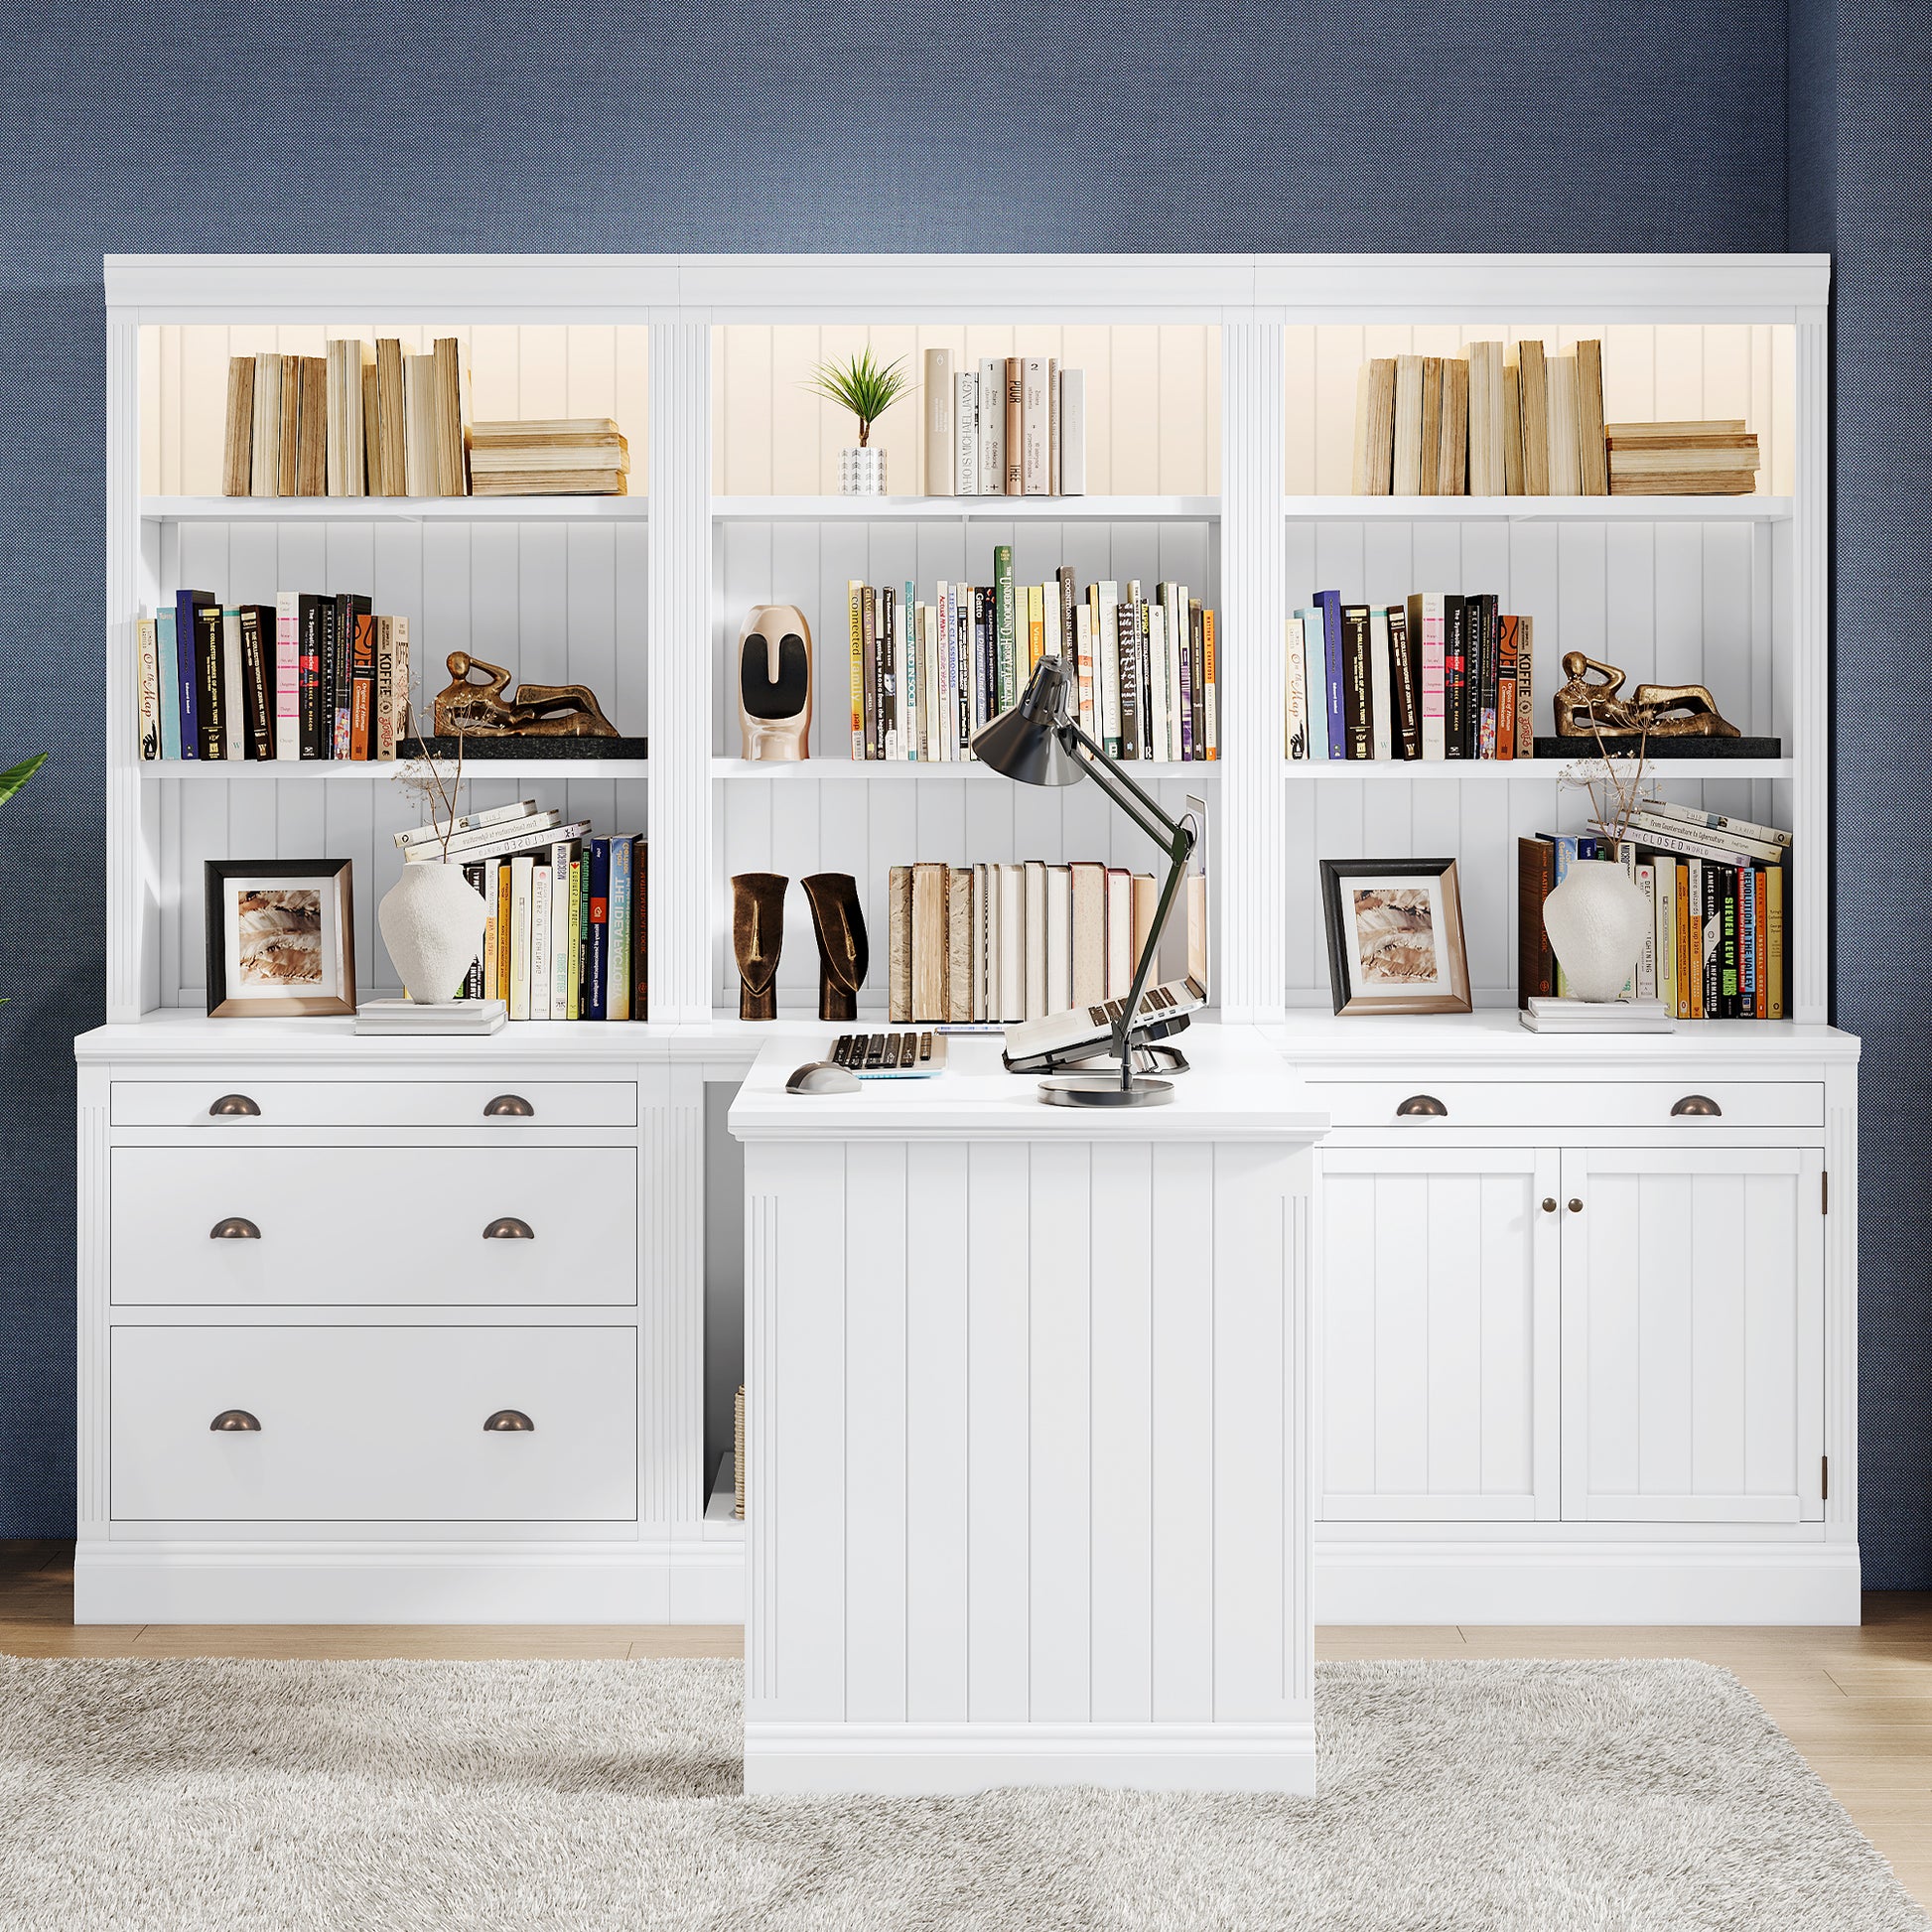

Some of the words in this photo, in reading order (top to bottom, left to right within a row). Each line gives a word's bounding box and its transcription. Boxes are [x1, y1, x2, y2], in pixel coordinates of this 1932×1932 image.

[962, 380, 972, 411] JANG?
[1009, 380, 1021, 403] PUUR
[962, 415, 972, 457] MICHAEL
[962, 469, 972, 493] WHO
[1010, 465, 1021, 482] THEE
[851, 596, 862, 655] connected
[949, 616, 955, 625] IN
[1065, 621, 1071, 630] IN
[144, 653, 153, 669] On
[379, 653, 392, 698] KOFFIE
[1292, 653, 1301, 669] On
[1519, 653, 1531, 698] KOFFIE
[852, 660, 864, 702] family
[141, 680, 155, 717] Map
[979, 692, 986, 701] of
[1289, 680, 1303, 717] Map
[378, 717, 392, 748] STORIES
[1517, 717, 1532, 748] STORIES
[1642, 833, 1684, 851] CLOSED
[1686, 844, 1709, 856] WORLD
[1662, 822, 1693, 837] Counterculture
[1699, 832, 1725, 844] Cyberculture
[1743, 872, 1752, 925] REVOLUTION
[1725, 897, 1733, 936] STEVEN
[1693, 931, 1699, 940] up
[1744, 927, 1752, 936] IN
[1723, 969, 1736, 996] HACKERS
[1744, 956, 1753, 989] VALLEY
